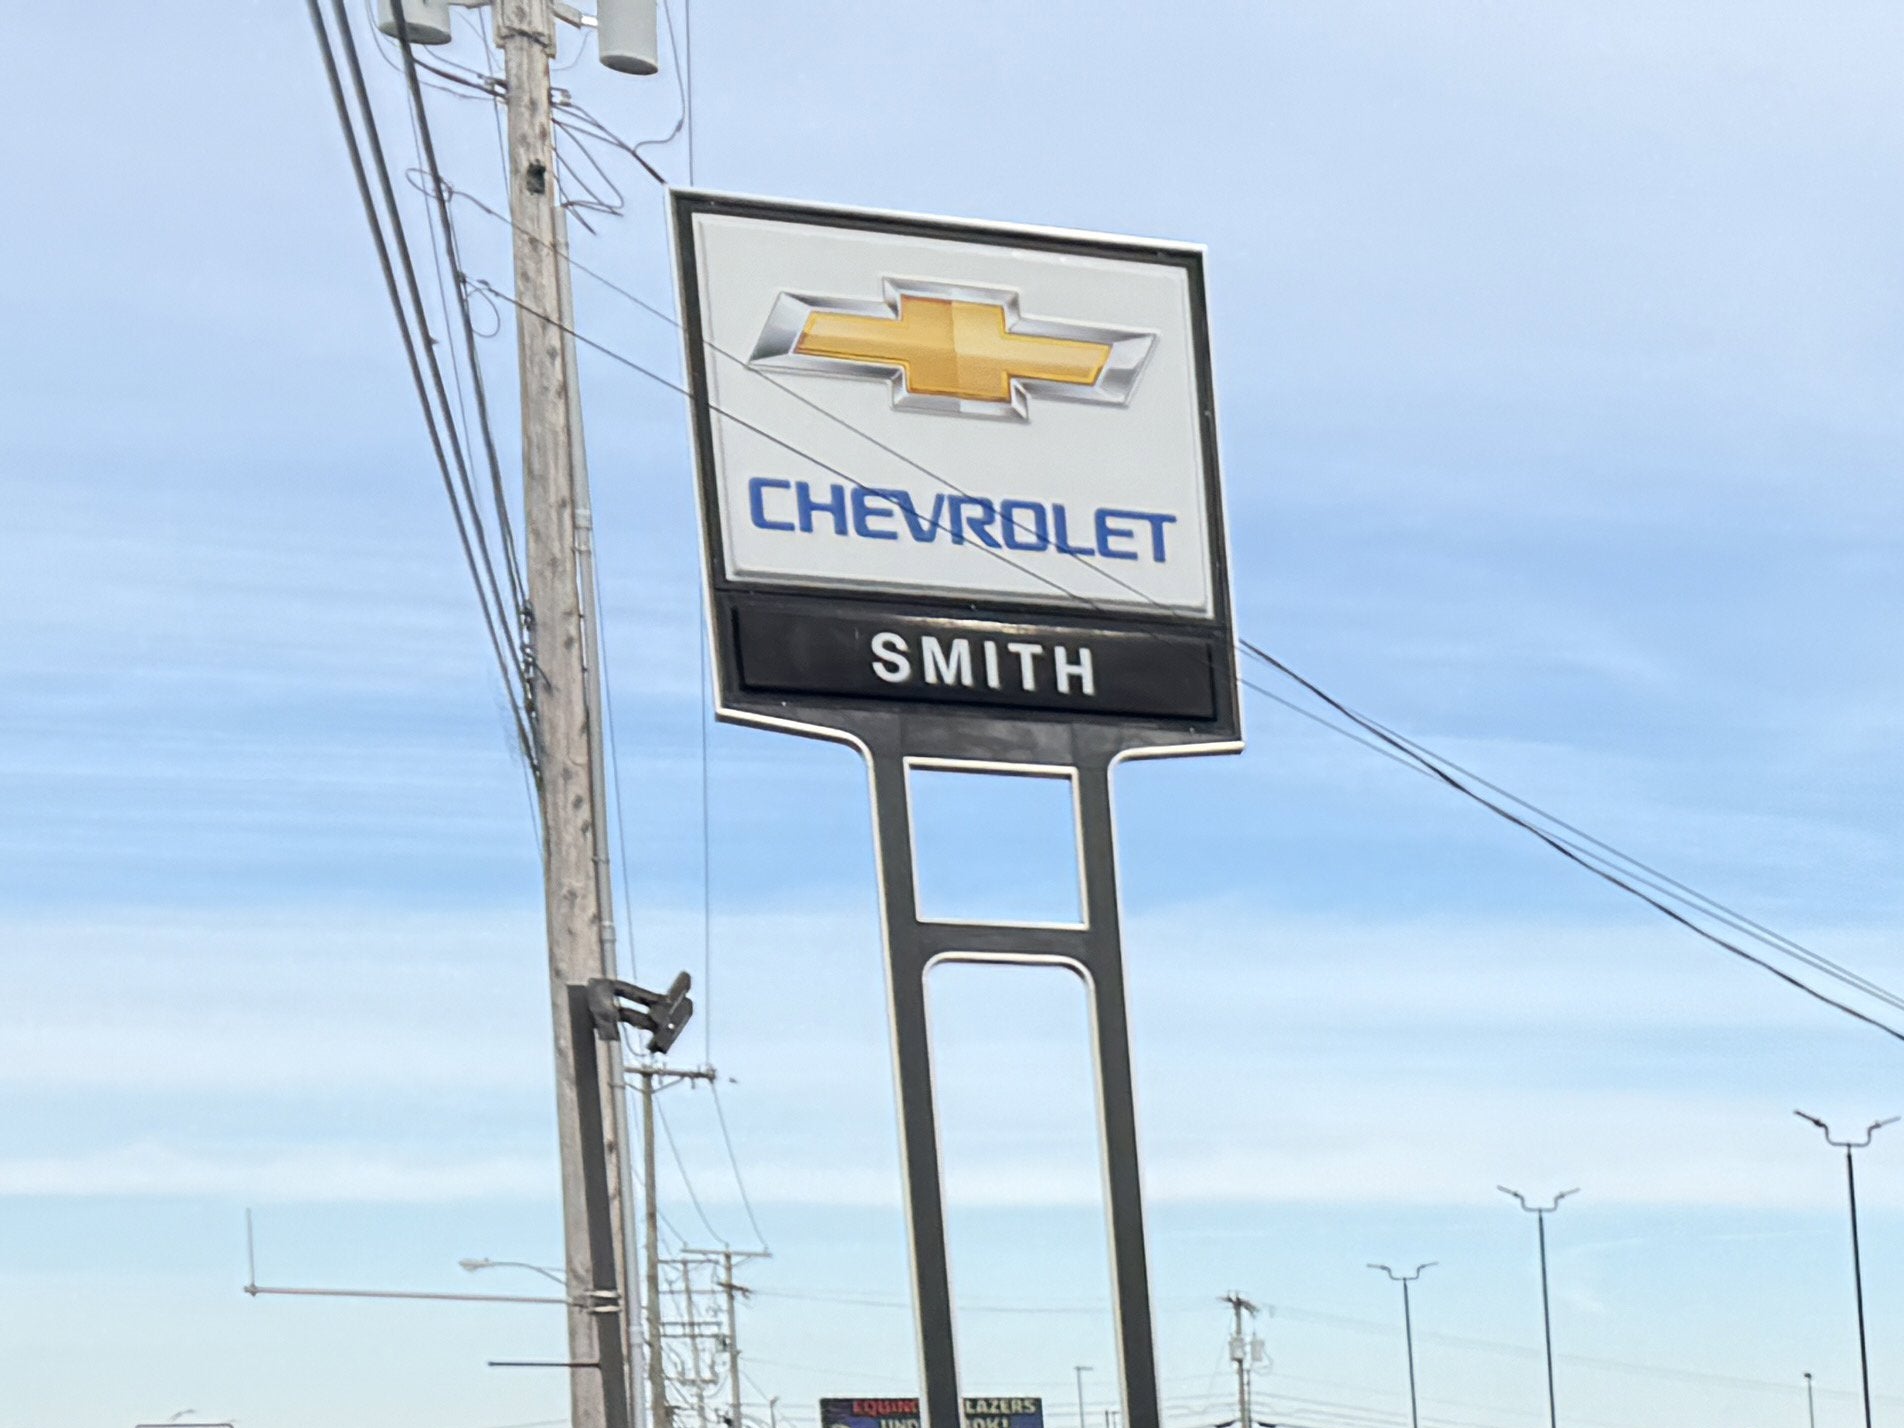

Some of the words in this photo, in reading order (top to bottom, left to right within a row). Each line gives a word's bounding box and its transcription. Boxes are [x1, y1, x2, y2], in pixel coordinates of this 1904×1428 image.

[749, 478, 1177, 563] CHEVROLET
[871, 632, 1095, 696] SMITH
[853, 1400, 919, 1417] EQUIN
[964, 1399, 1036, 1415] LAZERS
